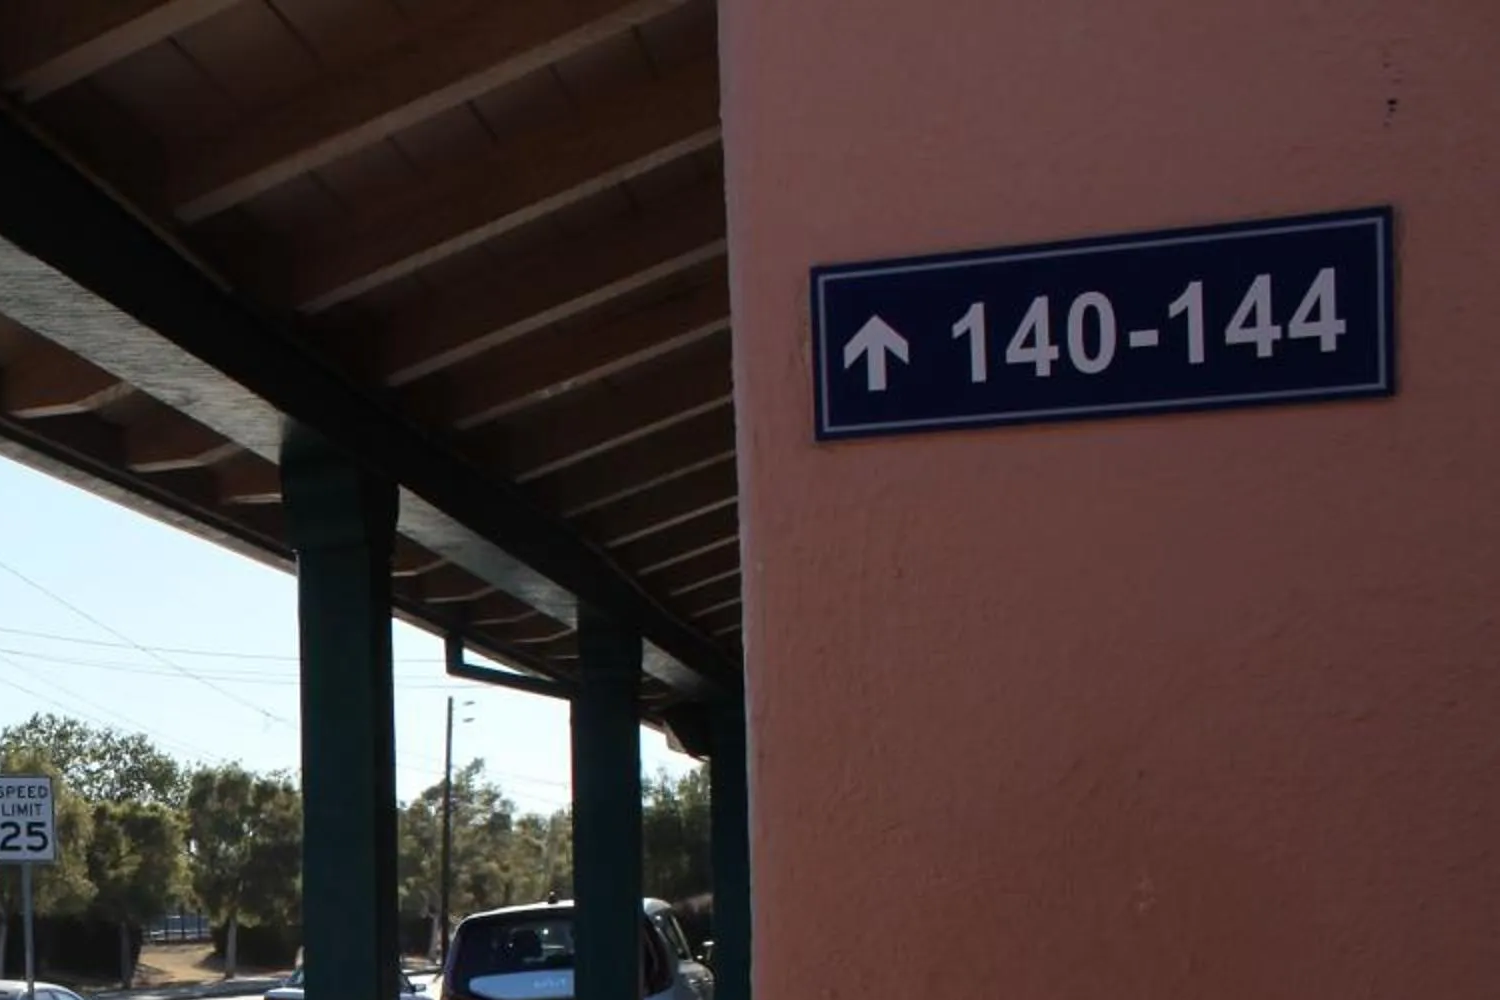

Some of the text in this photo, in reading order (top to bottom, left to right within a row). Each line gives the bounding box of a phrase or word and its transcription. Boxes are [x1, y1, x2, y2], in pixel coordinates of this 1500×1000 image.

[951, 267, 1347, 383] 140-144
[1, 803, 44, 817] LIMIT
[0, 821, 49, 852] 25
